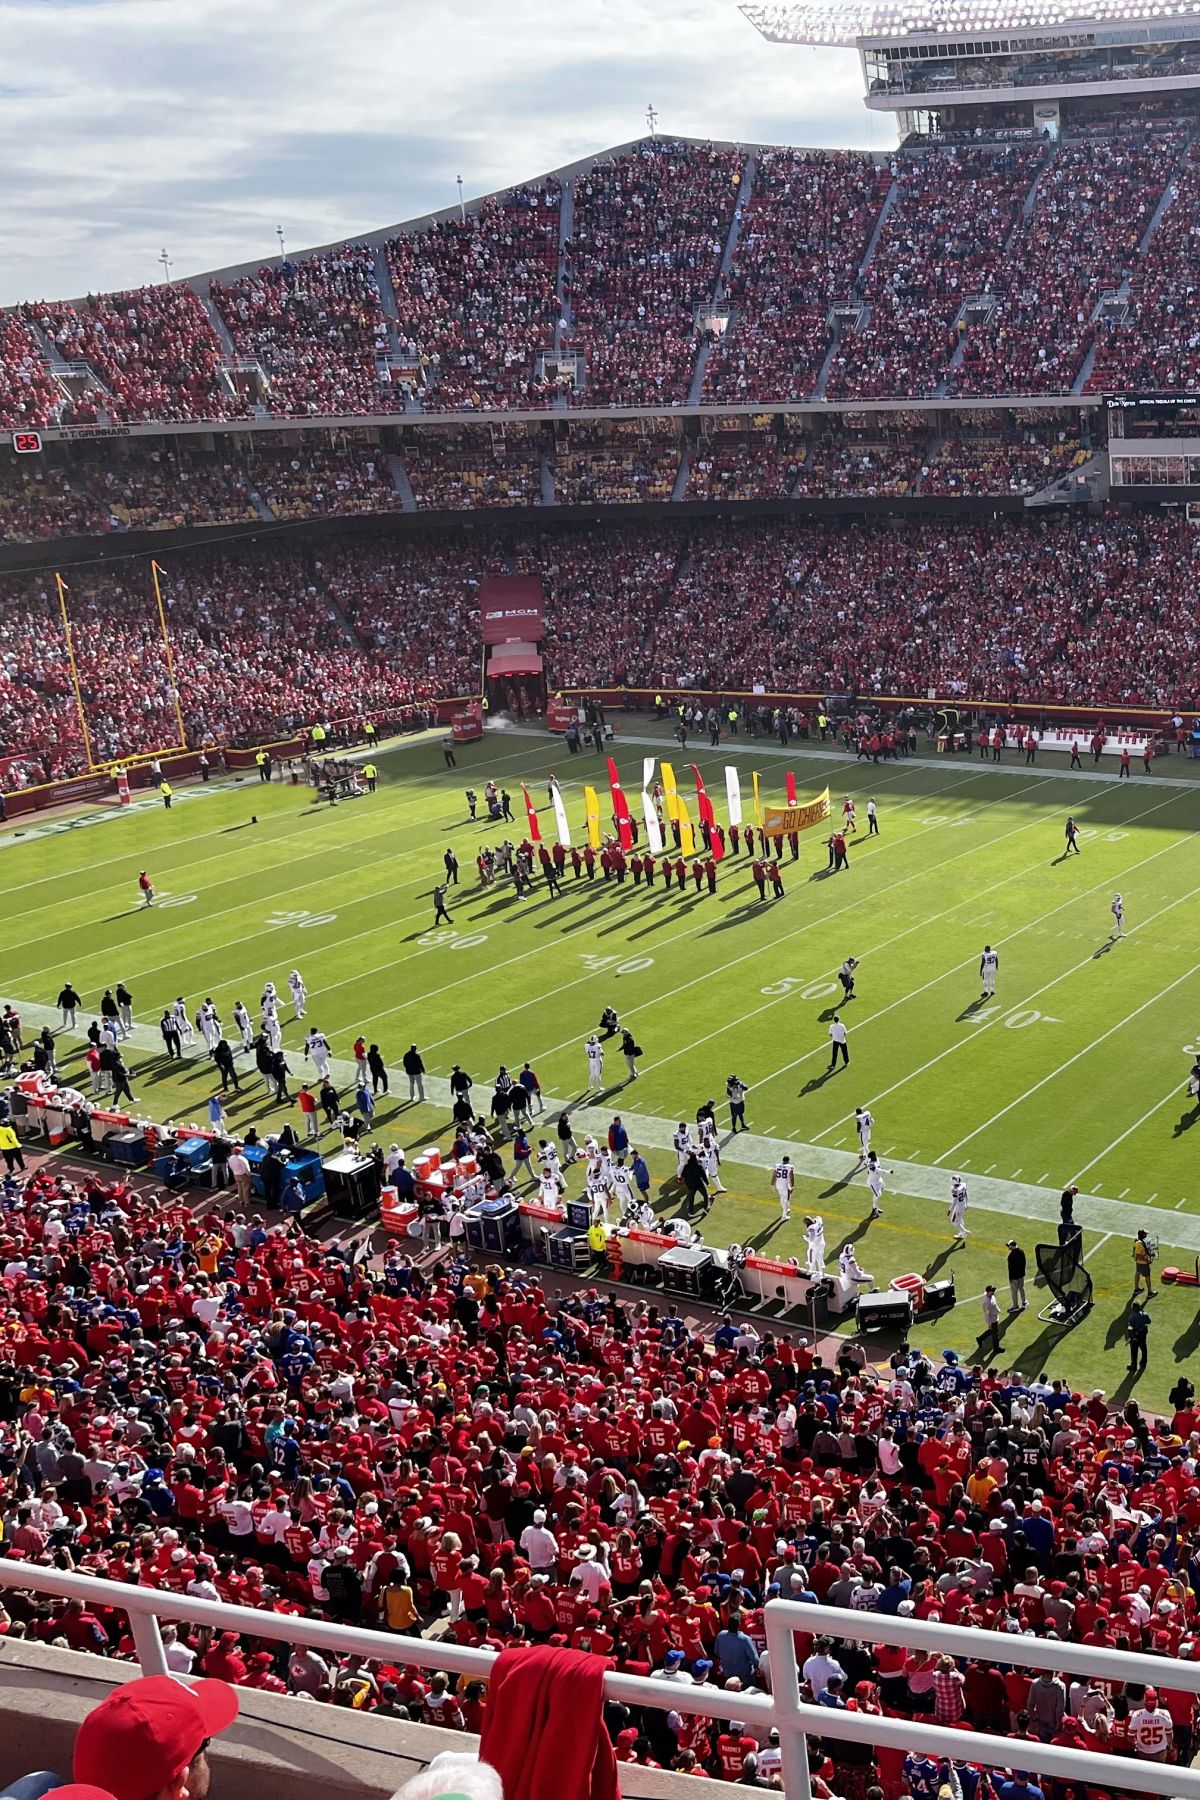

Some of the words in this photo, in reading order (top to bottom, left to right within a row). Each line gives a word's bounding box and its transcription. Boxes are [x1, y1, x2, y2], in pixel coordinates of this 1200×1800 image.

[79, 427, 130, 438] GRUNHARD
[18, 435, 37, 450] 25
[783, 811, 796, 829] GO
[264, 910, 339, 928] 20
[417, 930, 489, 949] 30
[581, 954, 655, 973] 40
[760, 977, 838, 1000] 50
[957, 1005, 1042, 1029] 40
[310, 1041, 323, 1049] 73
[614, 1175, 626, 1184] 10
[776, 1168, 788, 1179] 58
[592, 1184, 604, 1193] 30
[172, 1214, 183, 1224] 15
[293, 1279, 309, 1291] 58
[324, 1276, 335, 1287] 15
[321, 1360, 332, 1370] 15
[287, 1366, 303, 1378] 17
[170, 1381, 184, 1391] 15
[744, 1381, 759, 1393] 32
[868, 1406, 882, 1419] 32
[650, 1432, 665, 1446] 15
[733, 1431, 745, 1442] 15
[609, 1440, 621, 1450] 15
[274, 1450, 286, 1466] 12
[1023, 1454, 1038, 1465] 15
[788, 1510, 800, 1521] 15
[287, 1537, 303, 1553] 15
[437, 1562, 447, 1573] 15
[616, 1560, 632, 1572] 15
[1085, 1569, 1098, 1582] 15
[1120, 1578, 1134, 1591] 15
[1139, 1726, 1164, 1745] 25
